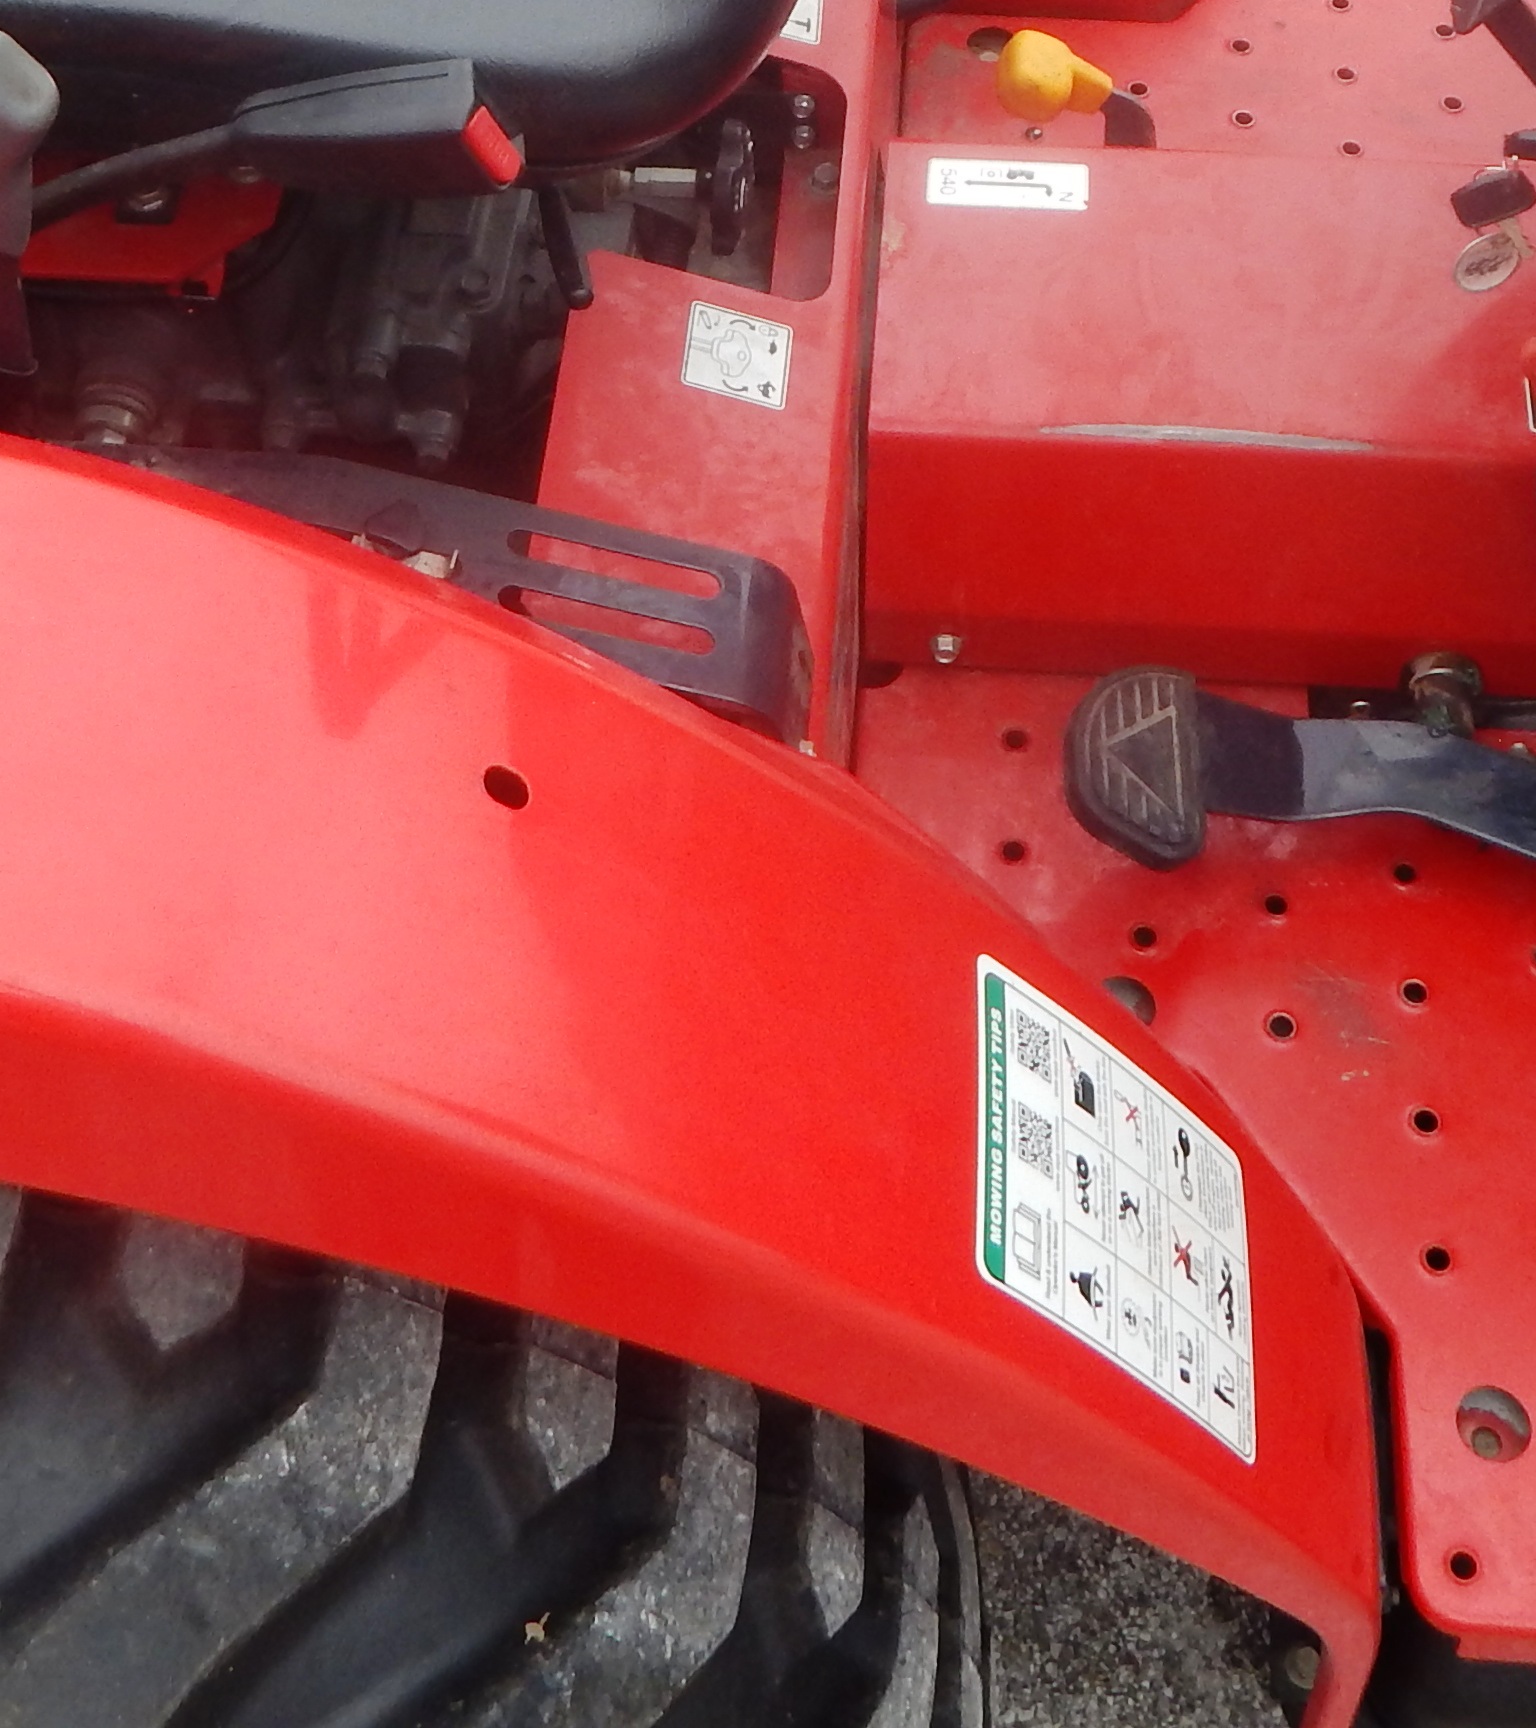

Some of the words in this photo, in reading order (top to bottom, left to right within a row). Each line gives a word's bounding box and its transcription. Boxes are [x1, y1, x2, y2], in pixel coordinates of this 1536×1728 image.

[939, 167, 958, 196] 540
[990, 1006, 1003, 1055] TIPS
[990, 1058, 1003, 1144] SAFETY
[989, 1146, 1003, 1246] MOWING
